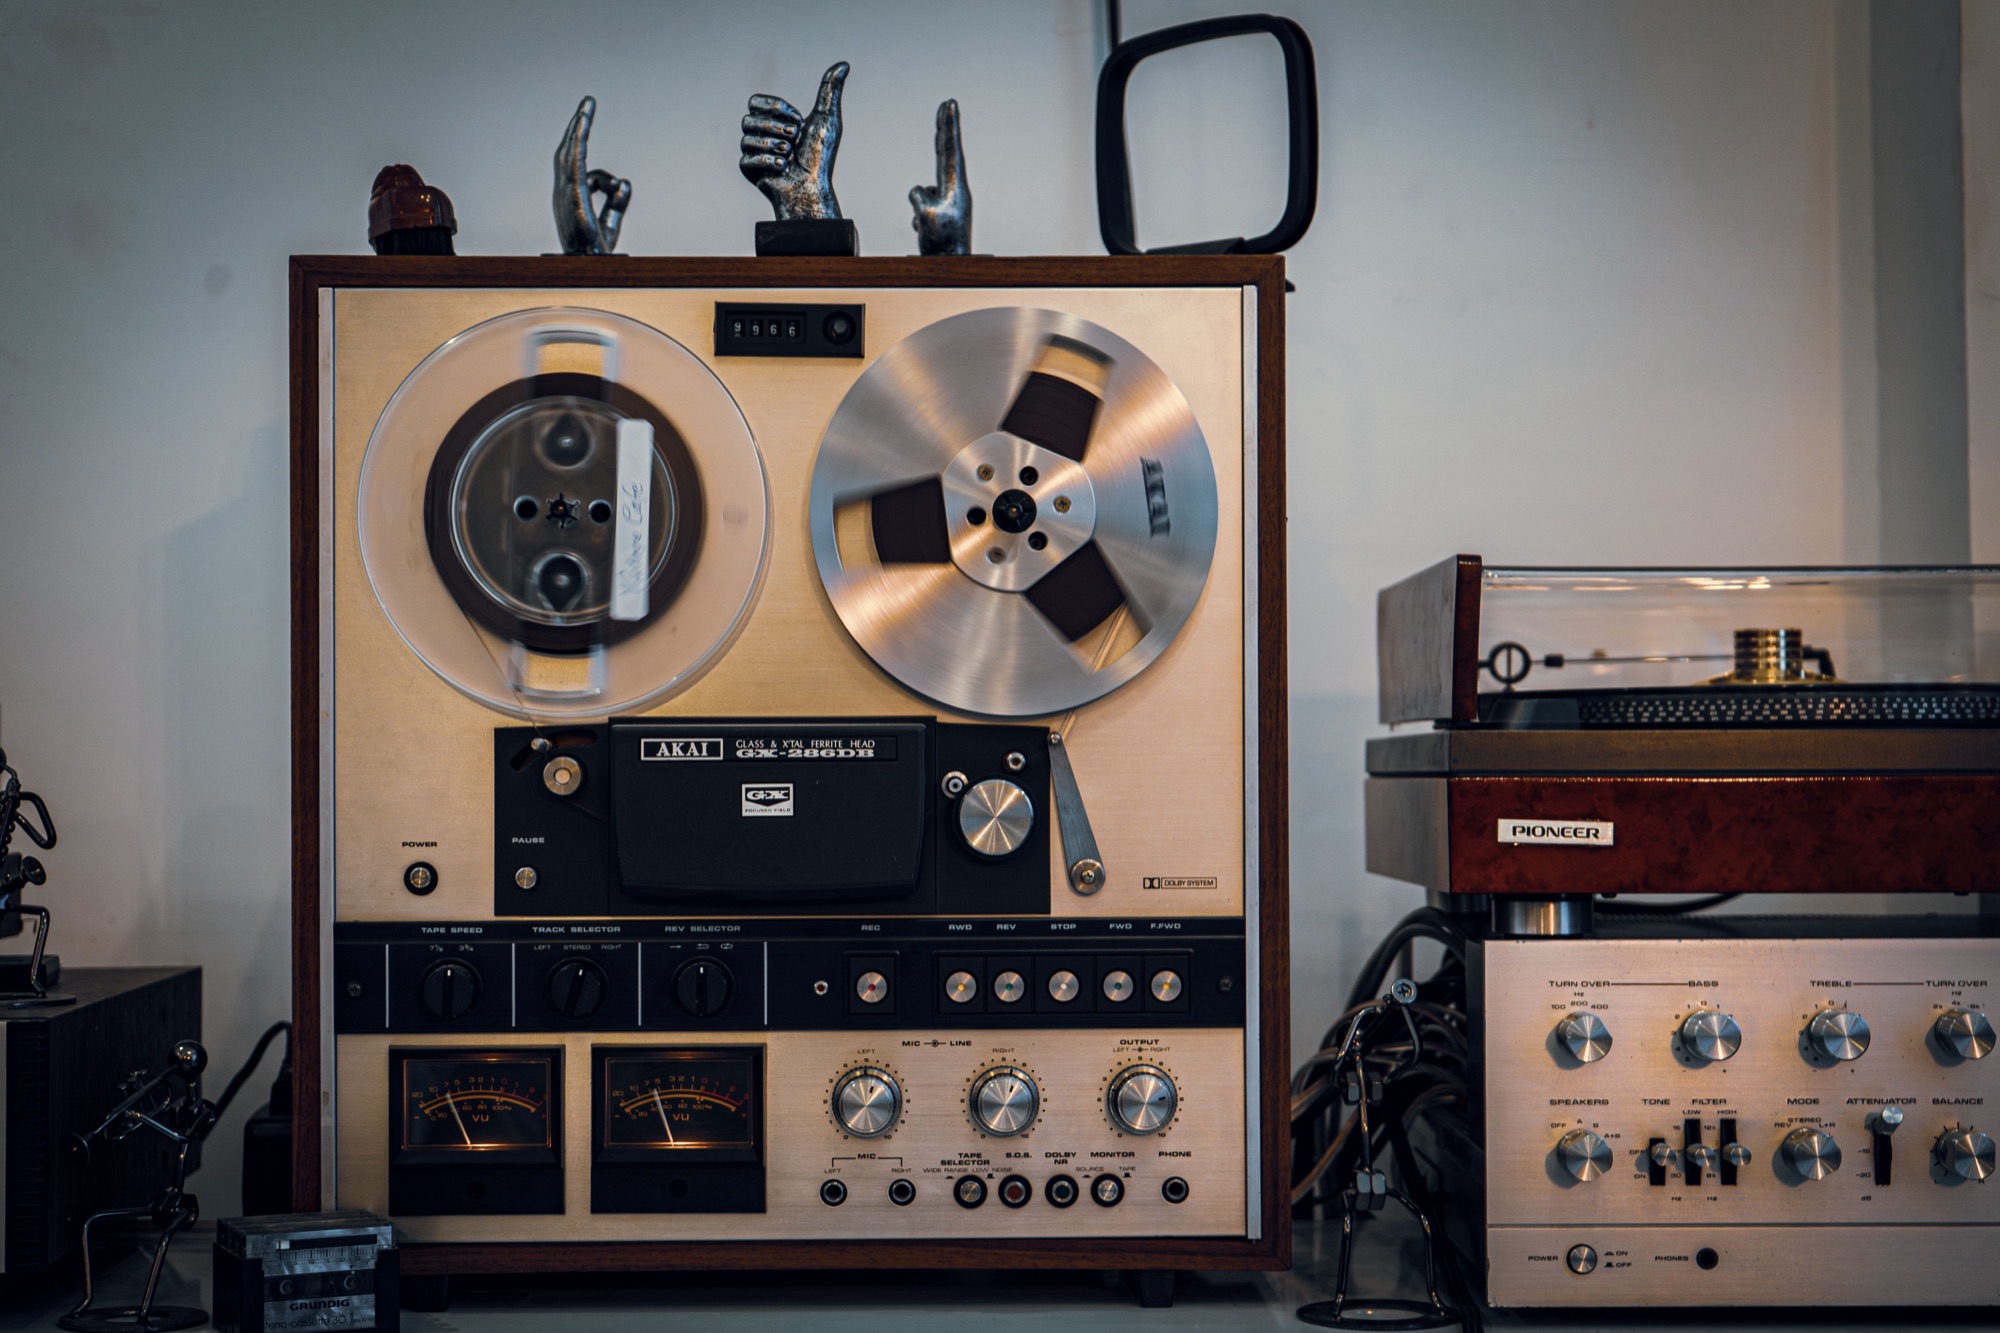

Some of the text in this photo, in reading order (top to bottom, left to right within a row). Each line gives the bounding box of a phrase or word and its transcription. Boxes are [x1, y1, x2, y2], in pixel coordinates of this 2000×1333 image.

[657, 743, 708, 756] AKAI
[736, 749, 874, 758] GX-286DB
[747, 790, 788, 800] GX
[1512, 826, 1599, 838] PIONEER
[290, 1300, 350, 1310] GRUNDIG
[333, 1315, 346, 1324] 30
